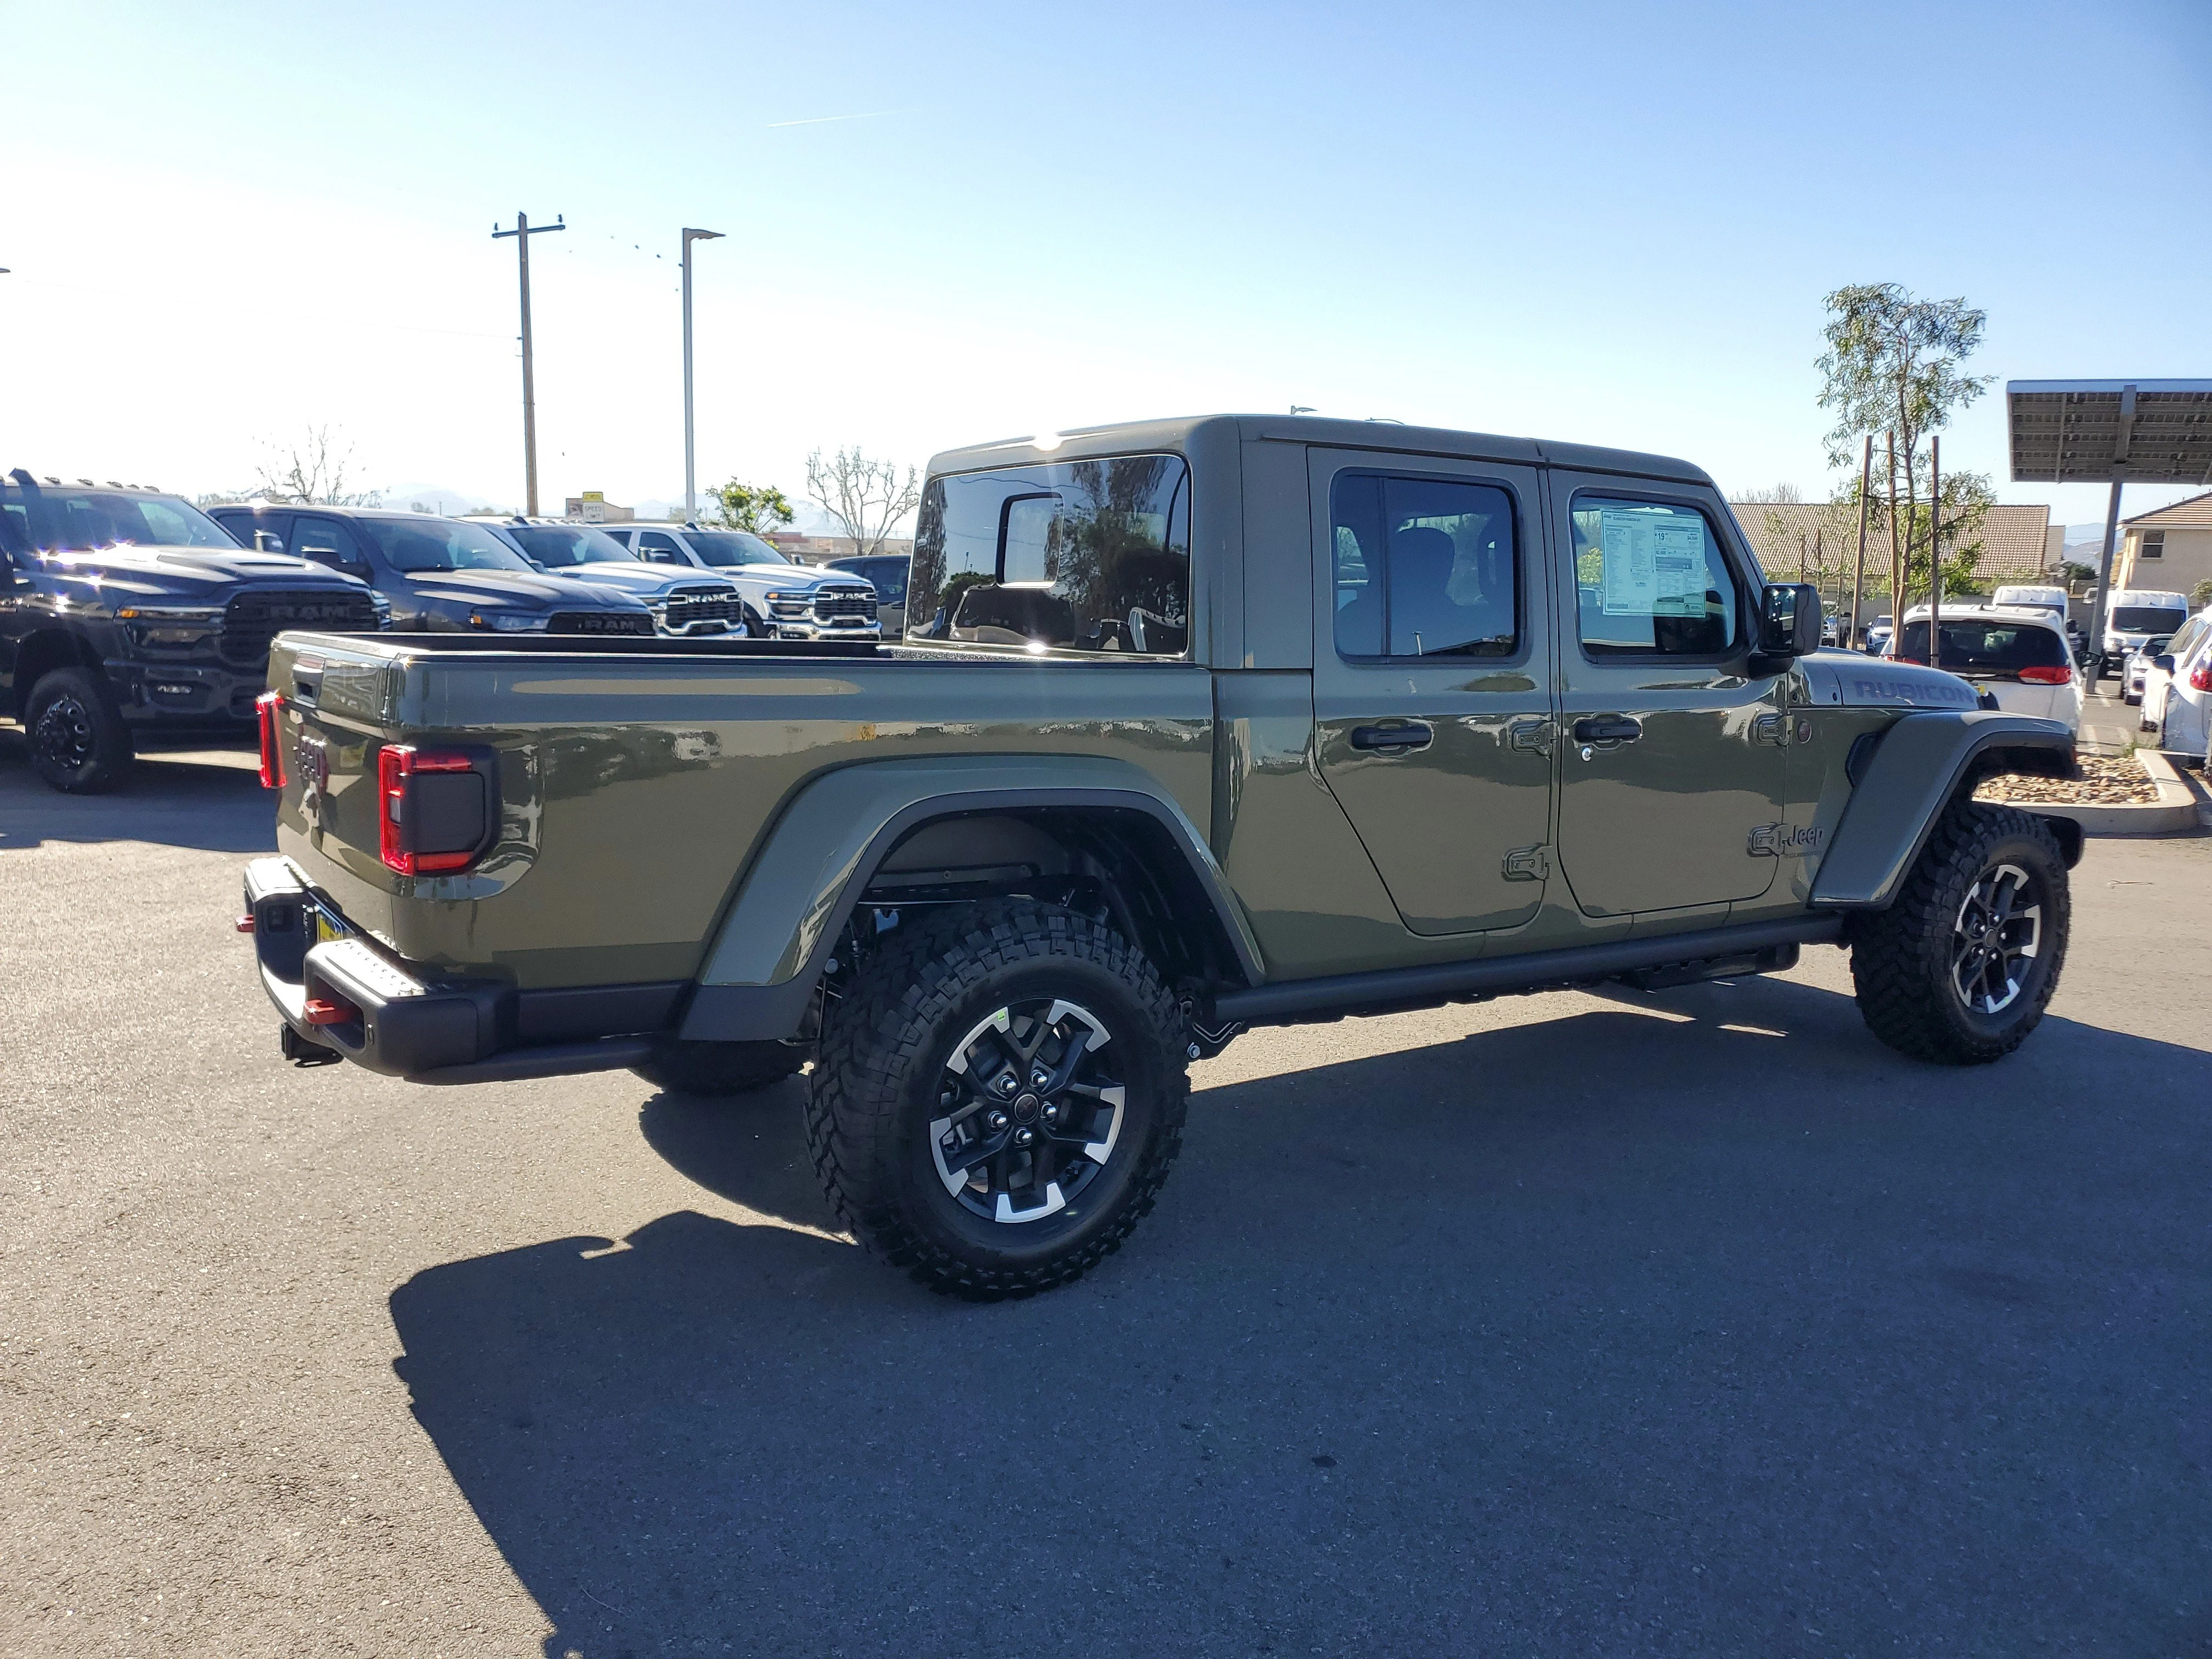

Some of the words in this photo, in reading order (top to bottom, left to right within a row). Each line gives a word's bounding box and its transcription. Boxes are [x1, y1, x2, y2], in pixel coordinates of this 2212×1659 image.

[687, 593, 725, 603] RAM
[270, 605, 350, 619] RAM
[584, 620, 636, 630] RAM
[1853, 680, 1974, 704] RUBICON
[1786, 825, 1824, 847] Jeep
